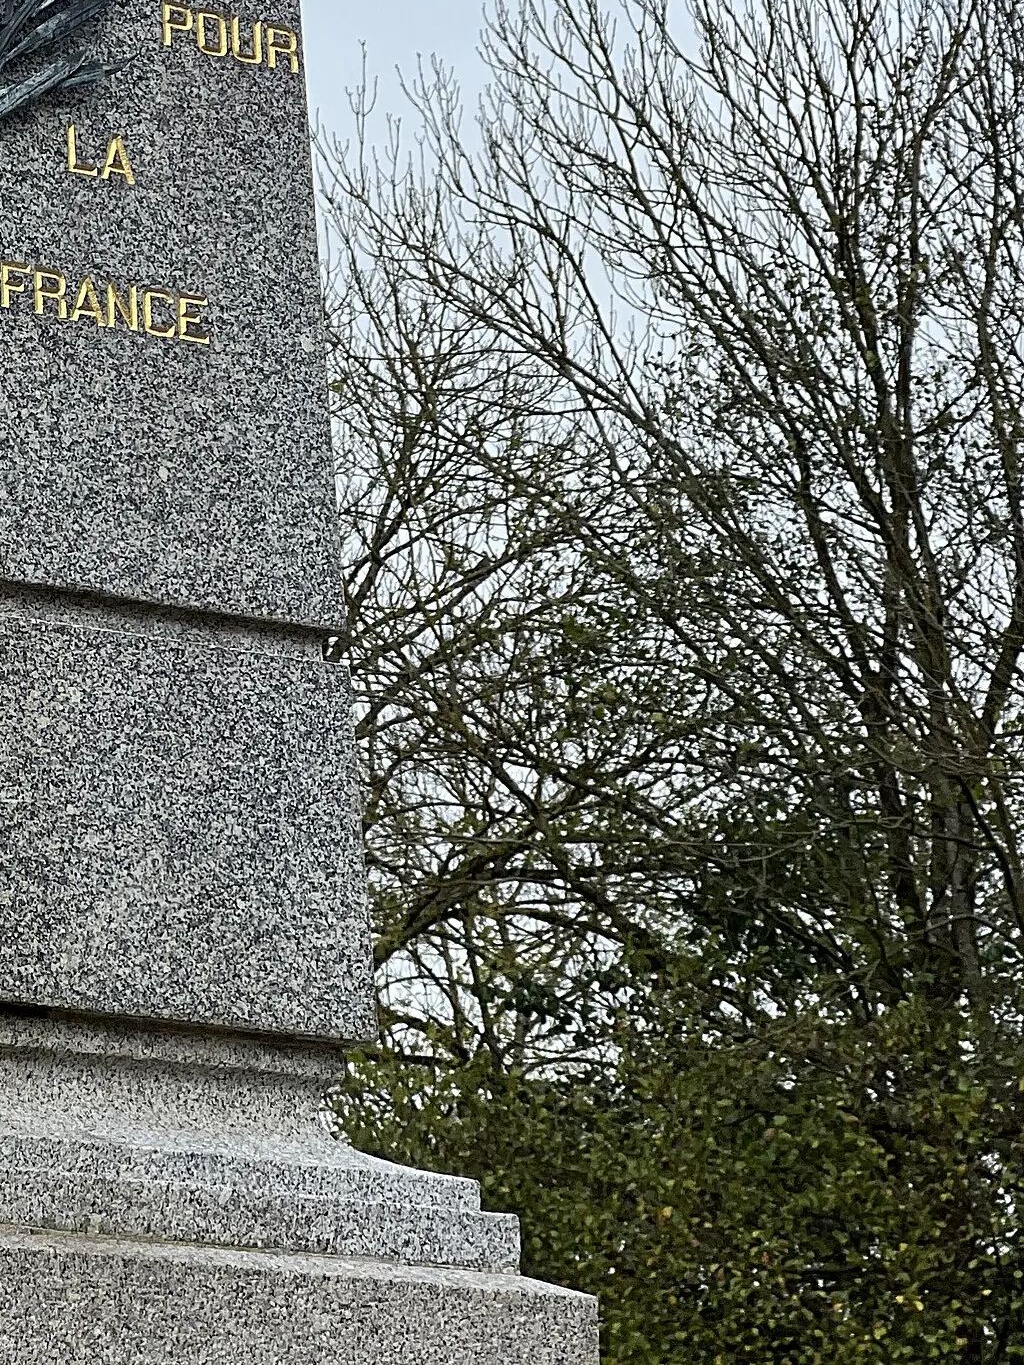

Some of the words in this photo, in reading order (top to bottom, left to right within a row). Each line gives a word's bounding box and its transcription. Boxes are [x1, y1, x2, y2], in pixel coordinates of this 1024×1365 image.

[162, 1, 299, 73] POUR
[67, 125, 136, 185] LA
[1, 262, 211, 345] FRANCE
